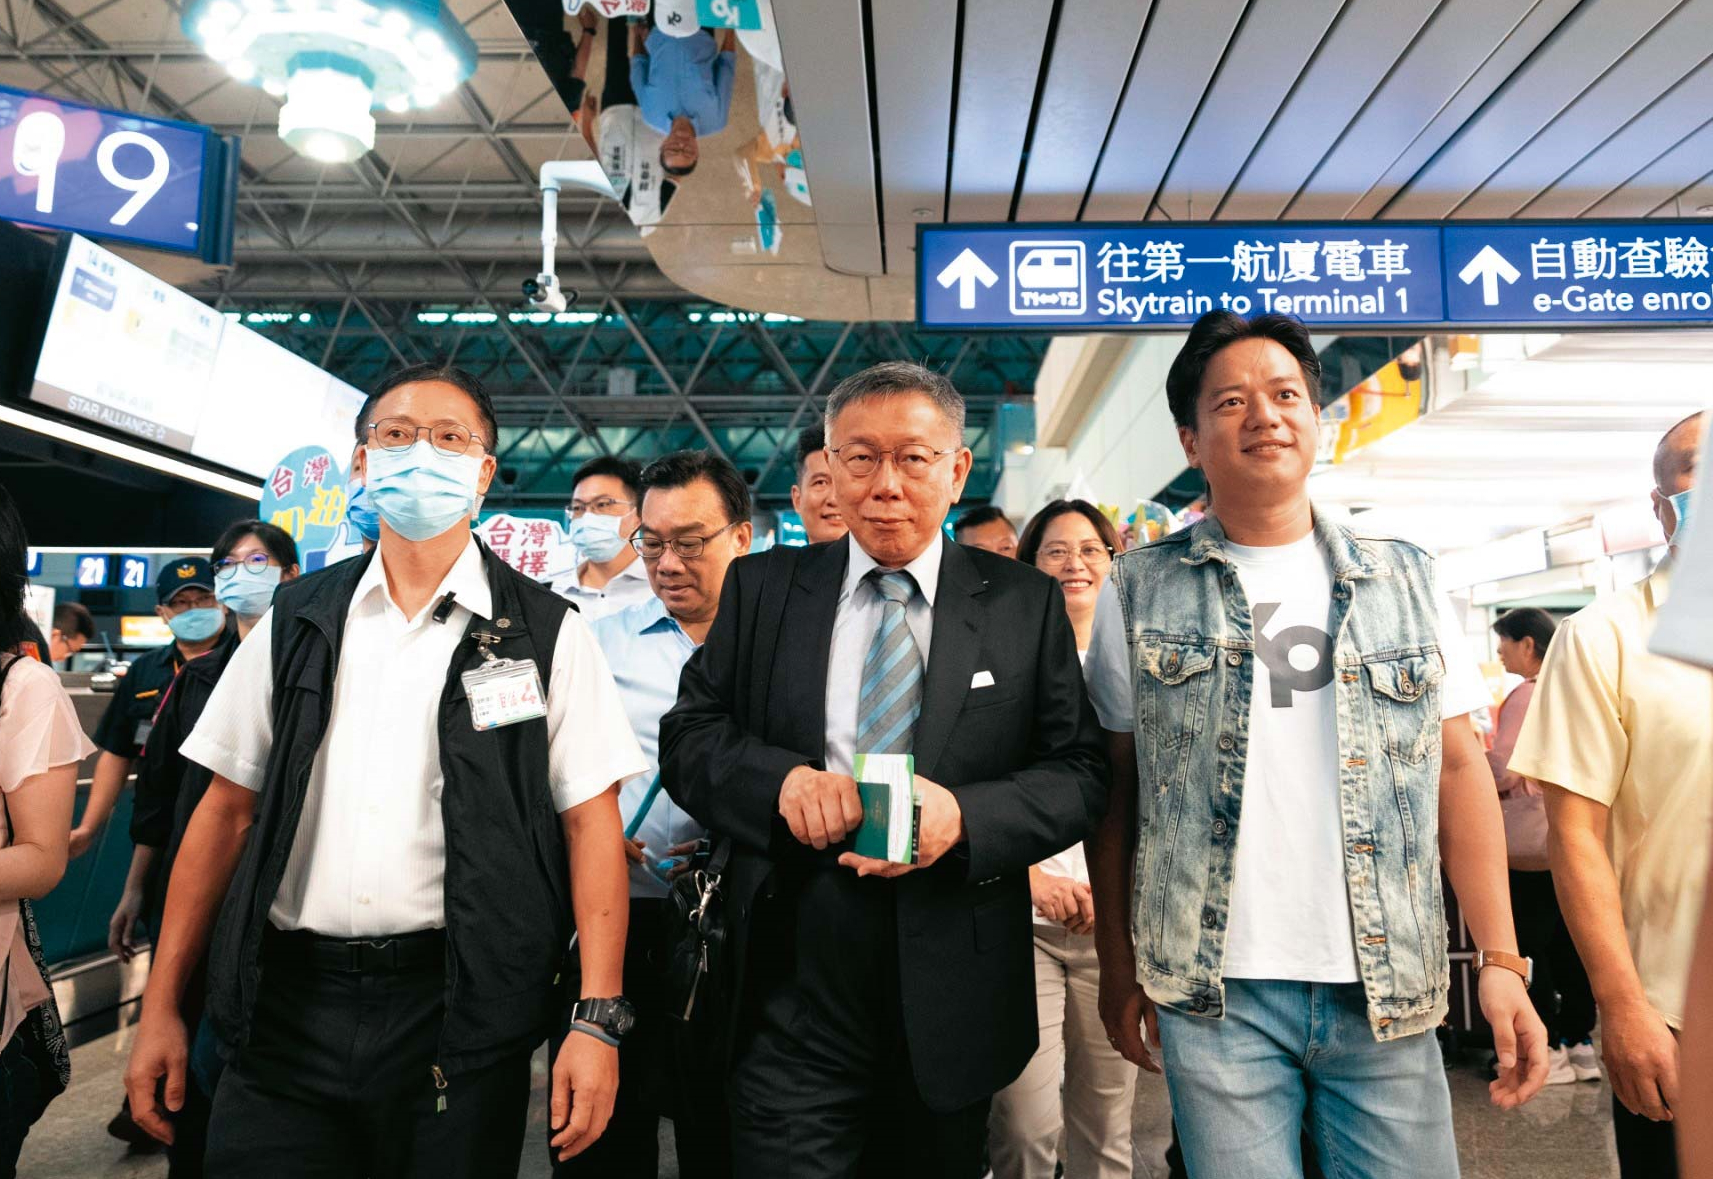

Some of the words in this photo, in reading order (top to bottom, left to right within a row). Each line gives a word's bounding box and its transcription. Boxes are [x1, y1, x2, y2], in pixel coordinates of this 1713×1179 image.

[1096, 238, 1412, 284] 往第一航廈電車
[1530, 236, 1713, 281] 自動查驗
[1096, 288, 1213, 322] Skytrain
[1219, 291, 1252, 315] to
[1257, 286, 1385, 315] Terminal
[1395, 287, 1409, 314] 1
[1533, 285, 1634, 313] e-Gate
[67, 395, 99, 420] STAR
[99, 403, 157, 439] ALLIANCE
[271, 454, 331, 498] 台灣
[488, 516, 553, 547] 台灣
[79, 557, 105, 586] 21
[123, 559, 145, 588] 21
